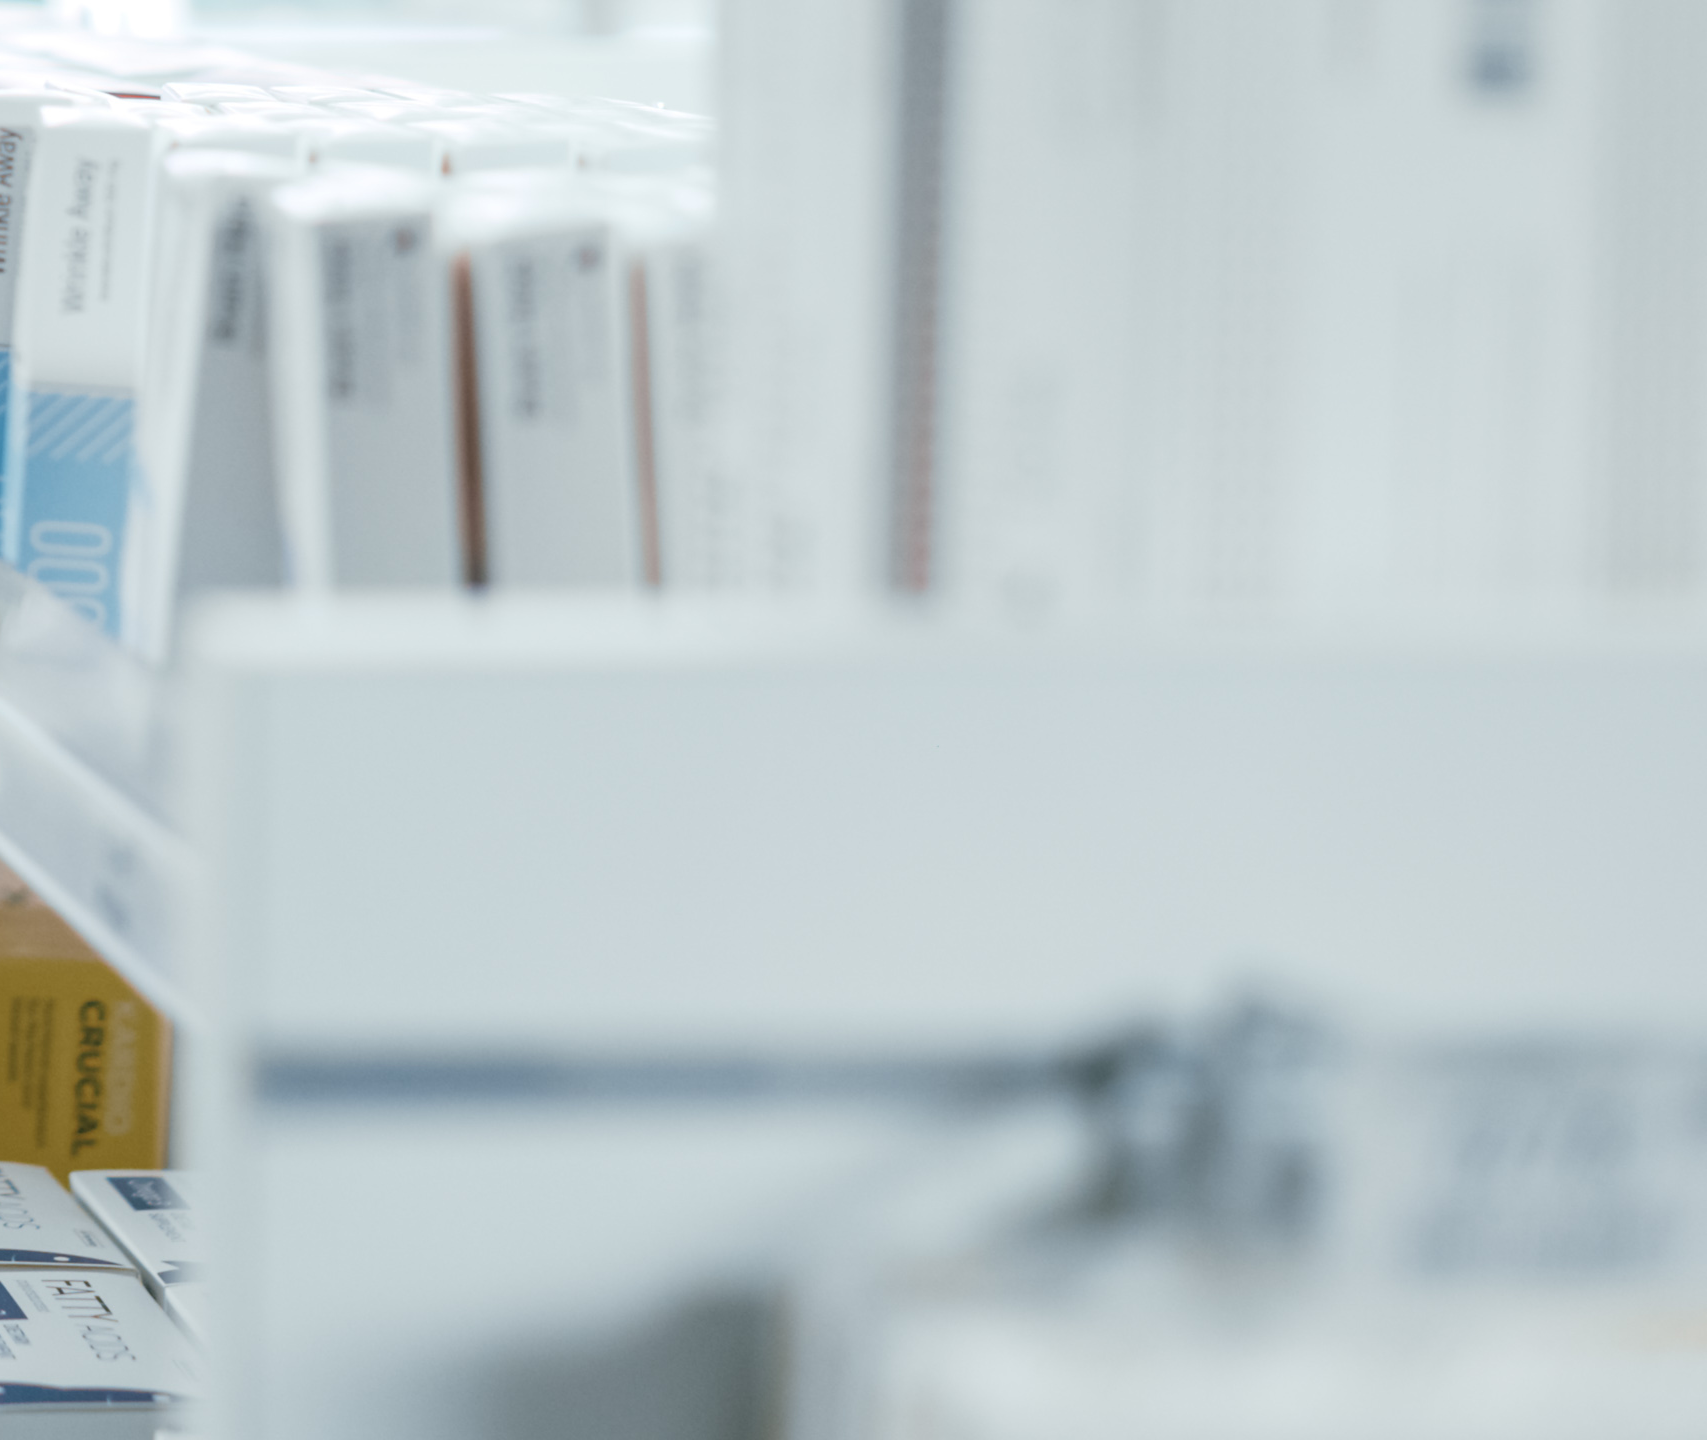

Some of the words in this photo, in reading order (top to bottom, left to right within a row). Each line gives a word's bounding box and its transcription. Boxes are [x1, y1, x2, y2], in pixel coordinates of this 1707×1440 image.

[66, 158, 100, 225] Away
[71, 999, 106, 1157] CRUCIAL
[41, 1279, 119, 1323] FATTY
